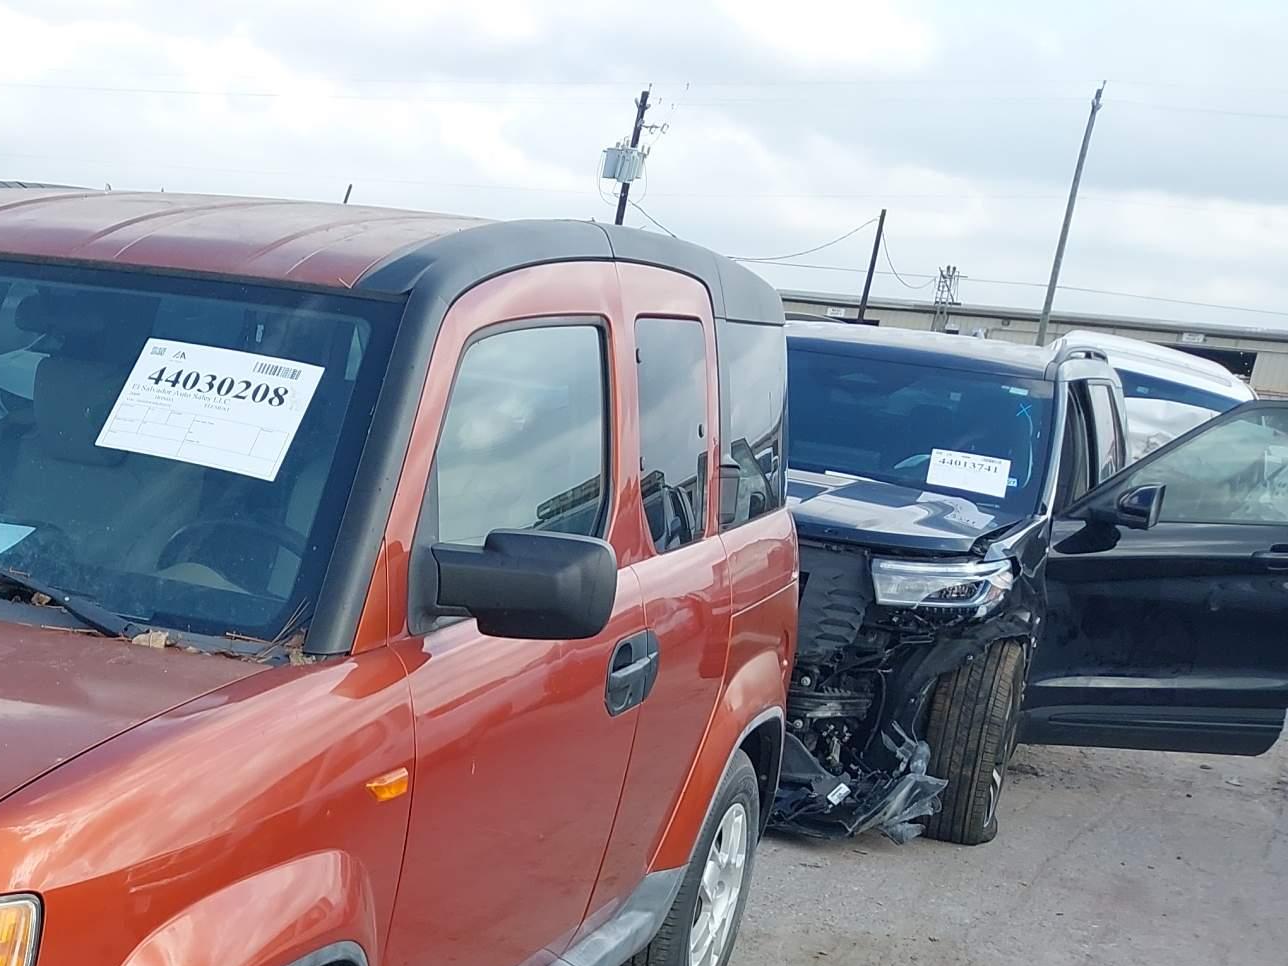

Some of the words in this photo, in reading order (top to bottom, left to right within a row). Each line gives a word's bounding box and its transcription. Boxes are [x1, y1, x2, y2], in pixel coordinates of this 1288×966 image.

[140, 384, 173, 396] Salvador
[174, 390, 192, 399] Auto
[193, 393, 211, 402] Sales
[147, 366, 290, 407] 44030208
[938, 457, 999, 474] 44013741
